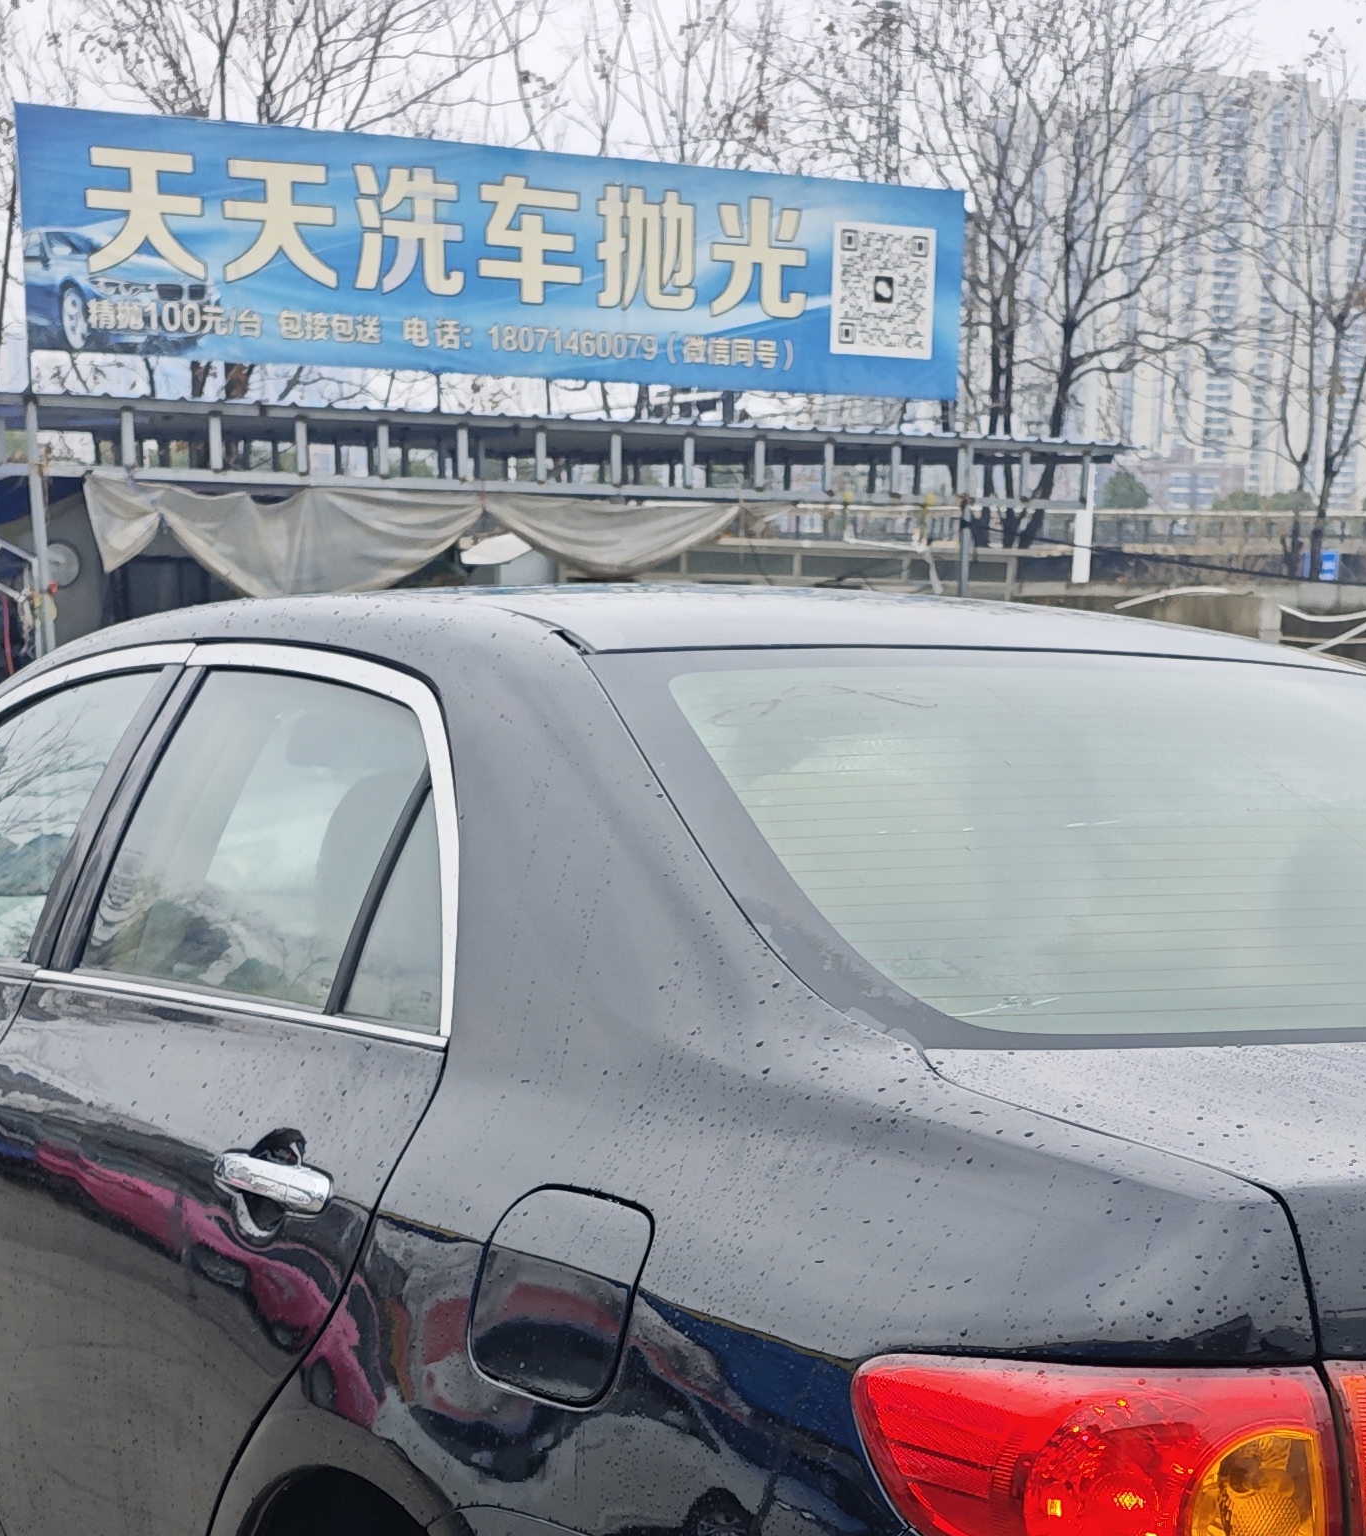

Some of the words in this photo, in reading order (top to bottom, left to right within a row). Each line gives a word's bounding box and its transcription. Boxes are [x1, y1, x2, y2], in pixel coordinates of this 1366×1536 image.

[85, 144, 810, 318] 天天洗车抛光
[278, 311, 382, 344] 包接包送
[488, 323, 659, 361] 18071460079
